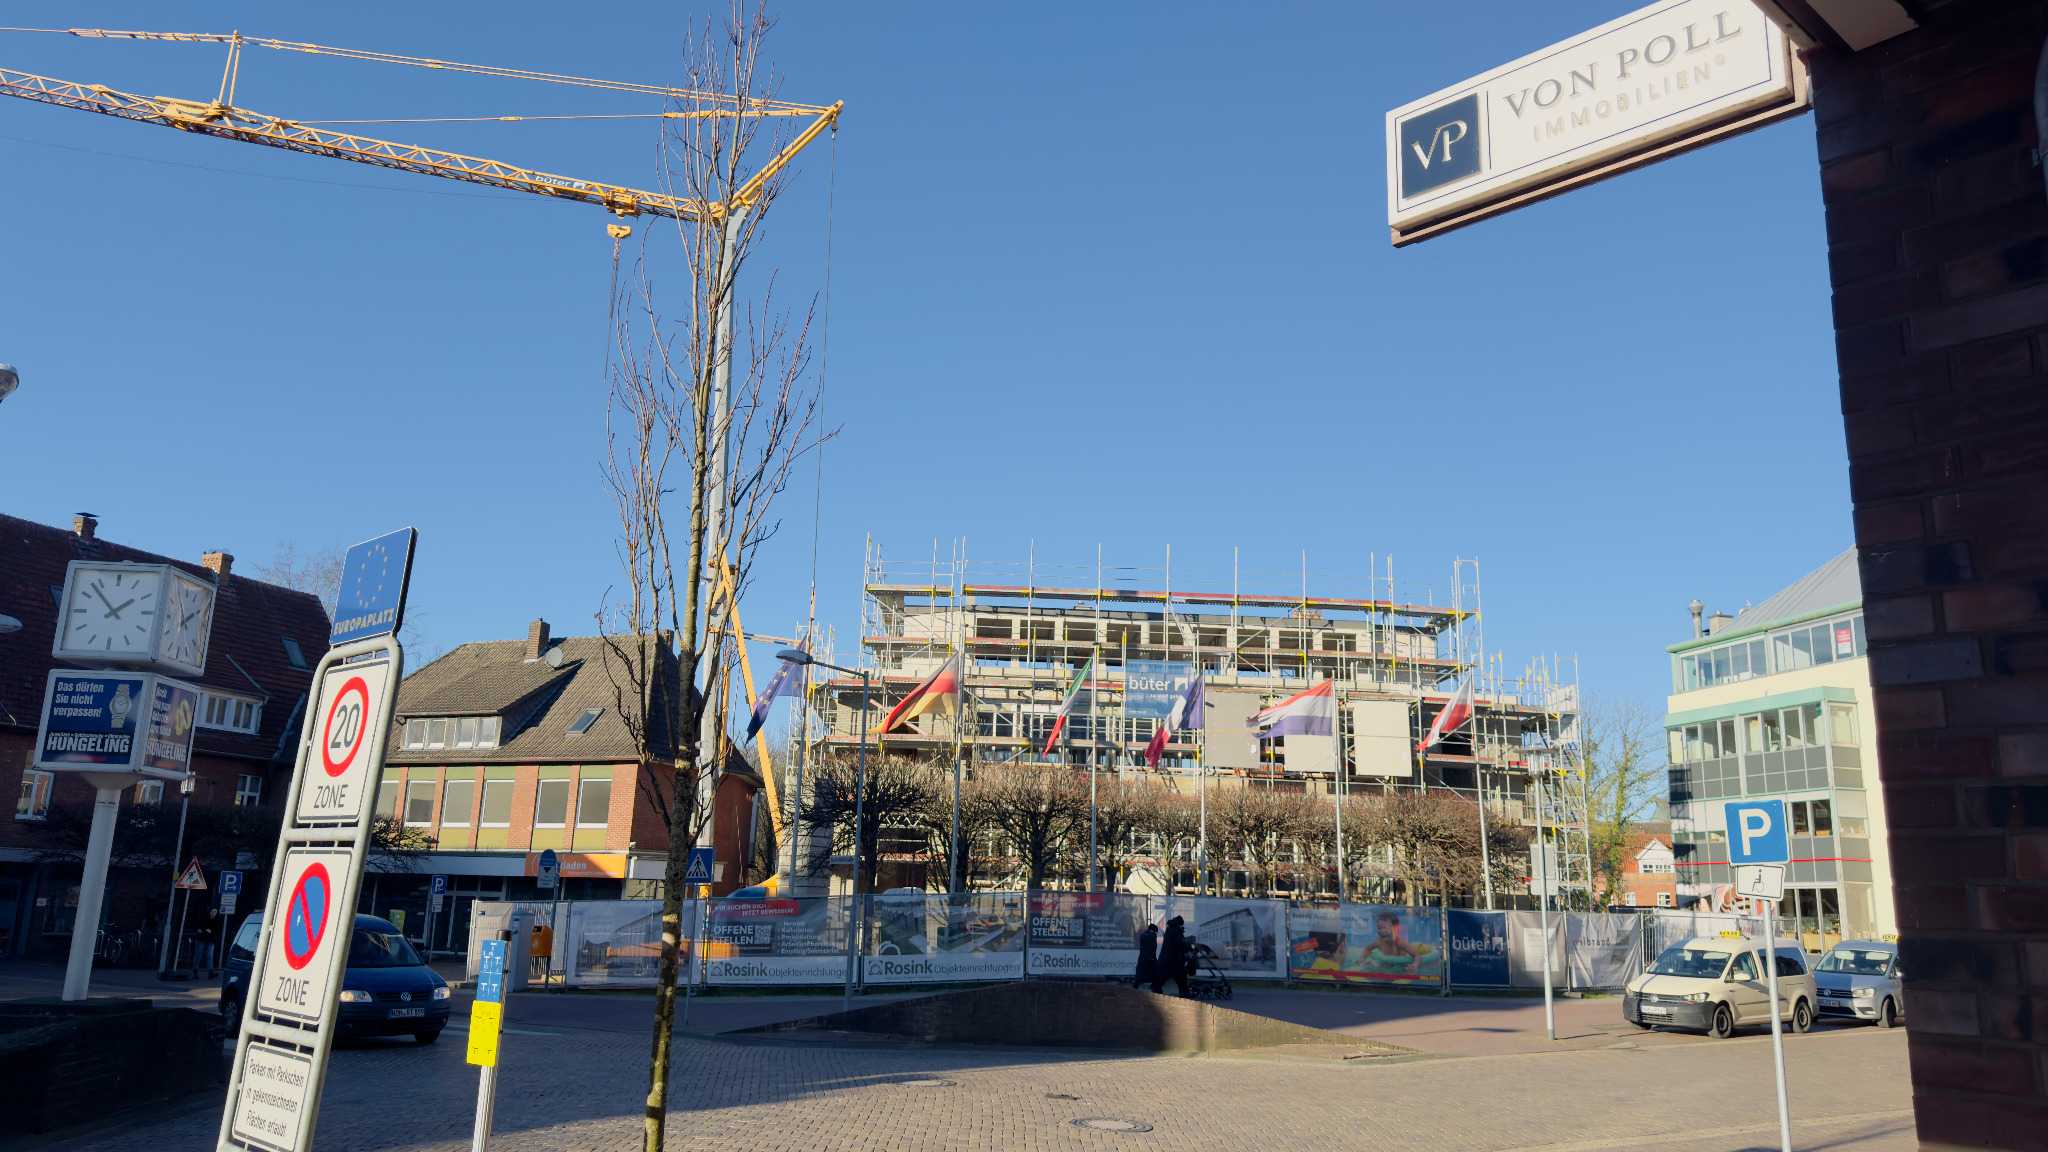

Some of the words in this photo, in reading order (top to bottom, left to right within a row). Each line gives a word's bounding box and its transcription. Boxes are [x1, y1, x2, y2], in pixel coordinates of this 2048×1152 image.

[1504, 62, 1599, 120] VON
[1617, 10, 1742, 79] POLL
[1411, 120, 1469, 171] VP
[334, 607, 394, 635] EUROPAPLATZ
[57, 681, 74, 692] Das
[75, 681, 104, 693] dürfen
[1128, 675, 1169, 691] büter
[55, 693, 71, 704] Sie
[71, 694, 93, 705] nicht
[53, 706, 103, 718] verpassen!
[331, 703, 361, 749] 20
[313, 783, 349, 809] ZONE
[1739, 807, 1772, 856] P
[713, 924, 754, 935] OFFENE
[1032, 917, 1069, 927] OFFENE
[1031, 927, 1069, 937] STELLEN
[1452, 935, 1489, 951] büter
[884, 959, 933, 975] Rosink
[1043, 953, 1080, 968] Rosink
[724, 962, 768, 977] Rosink
[275, 976, 310, 1006] ZONE
[249, 1059, 267, 1077] Parken
[275, 1064, 304, 1088] Parkschein
[252, 1088, 298, 1113] gekennzeichneten
